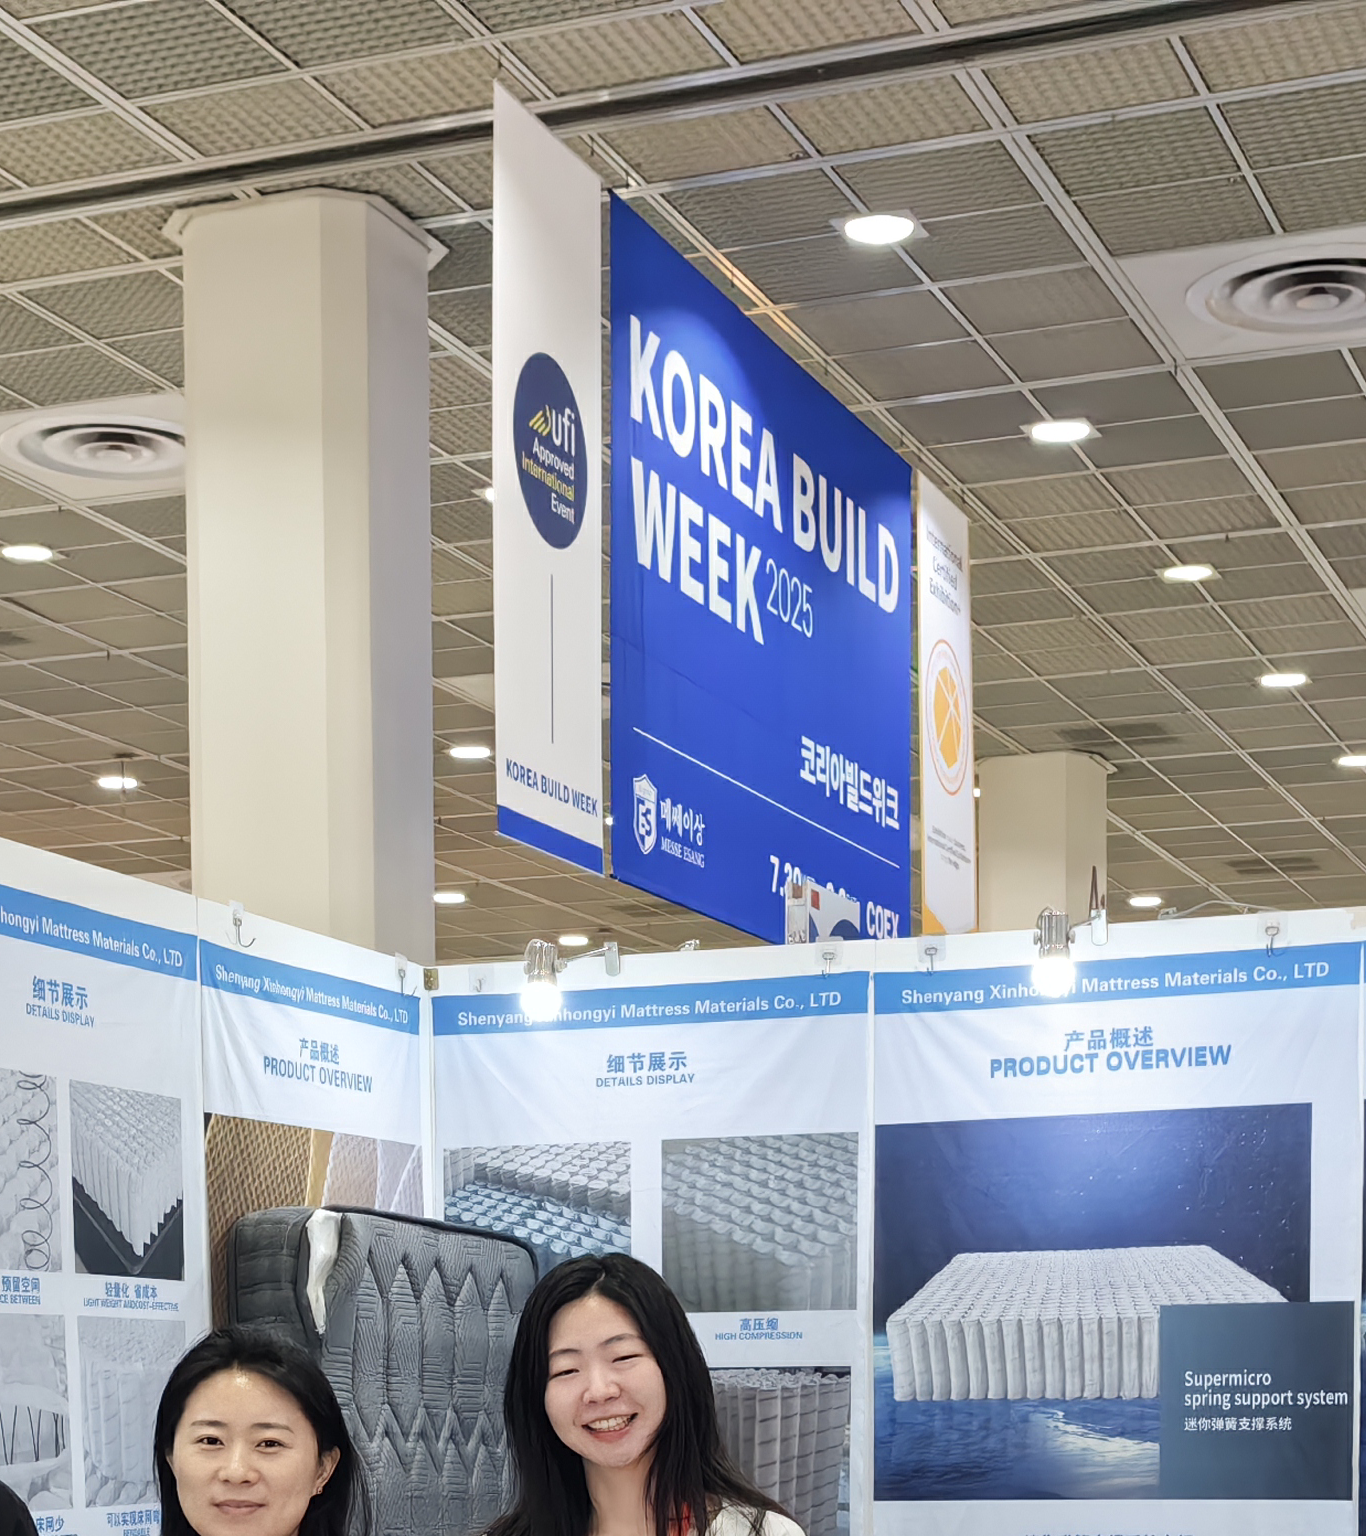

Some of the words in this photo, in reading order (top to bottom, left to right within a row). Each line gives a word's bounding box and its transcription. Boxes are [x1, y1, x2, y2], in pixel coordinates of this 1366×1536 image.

[533, 437, 575, 480] Approved
[630, 314, 783, 533] KOREA
[793, 453, 899, 613] BUILD
[522, 451, 575, 502] International
[551, 492, 575, 524] Event
[631, 456, 764, 645] WEEK
[766, 558, 813, 638] 2025
[506, 758, 539, 791] KOREA
[541, 775, 569, 803] BUILD
[572, 789, 597, 817] WEEK
[800, 735, 900, 830] 코리아빌드위크
[661, 836, 682, 858] MESSE
[683, 846, 704, 868] ESANG
[866, 901, 899, 940] COEX
[42, 917, 89, 945] Mattress
[93, 930, 139, 958] Materials
[163, 949, 183, 968] LTD
[32, 975, 88, 1010] 细节展示
[901, 986, 984, 1007] Shenyang
[1082, 973, 1160, 994] Mattress
[1164, 967, 1248, 988] Materials
[1294, 961, 1329, 980] LTD
[26, 1003, 60, 1021] DETAILS
[62, 1010, 95, 1028] DISPLAY
[306, 990, 340, 1008] Mattress
[342, 996, 377, 1017] Materials
[394, 1009, 408, 1024] LTD
[457, 1010, 532, 1028] Shenyang
[620, 1001, 691, 1020] Mattress
[695, 995, 769, 1015] Materials
[809, 991, 842, 1009] LTD
[299, 1037, 340, 1065] 产品概述
[1063, 1026, 1154, 1052] 产品概述
[263, 1056, 316, 1083] PRODUCT
[319, 1067, 373, 1093] OVERVIEW
[606, 1051, 687, 1074] 细节展示
[990, 1052, 1100, 1079] PRODUCT
[1106, 1045, 1232, 1071] OVERVIEW
[596, 1074, 643, 1088] DETAILS
[646, 1072, 695, 1086] DISPLAY
[715, 1331, 736, 1341] HIGH
[738, 1330, 803, 1341] COMPRESSION
[1185, 1369, 1271, 1390] Supermicro
[1184, 1389, 1231, 1410] spring
[1234, 1391, 1293, 1409] support
[1296, 1390, 1348, 1409] system
[1184, 1417, 1292, 1431] 迷你弹簧支撑系统
